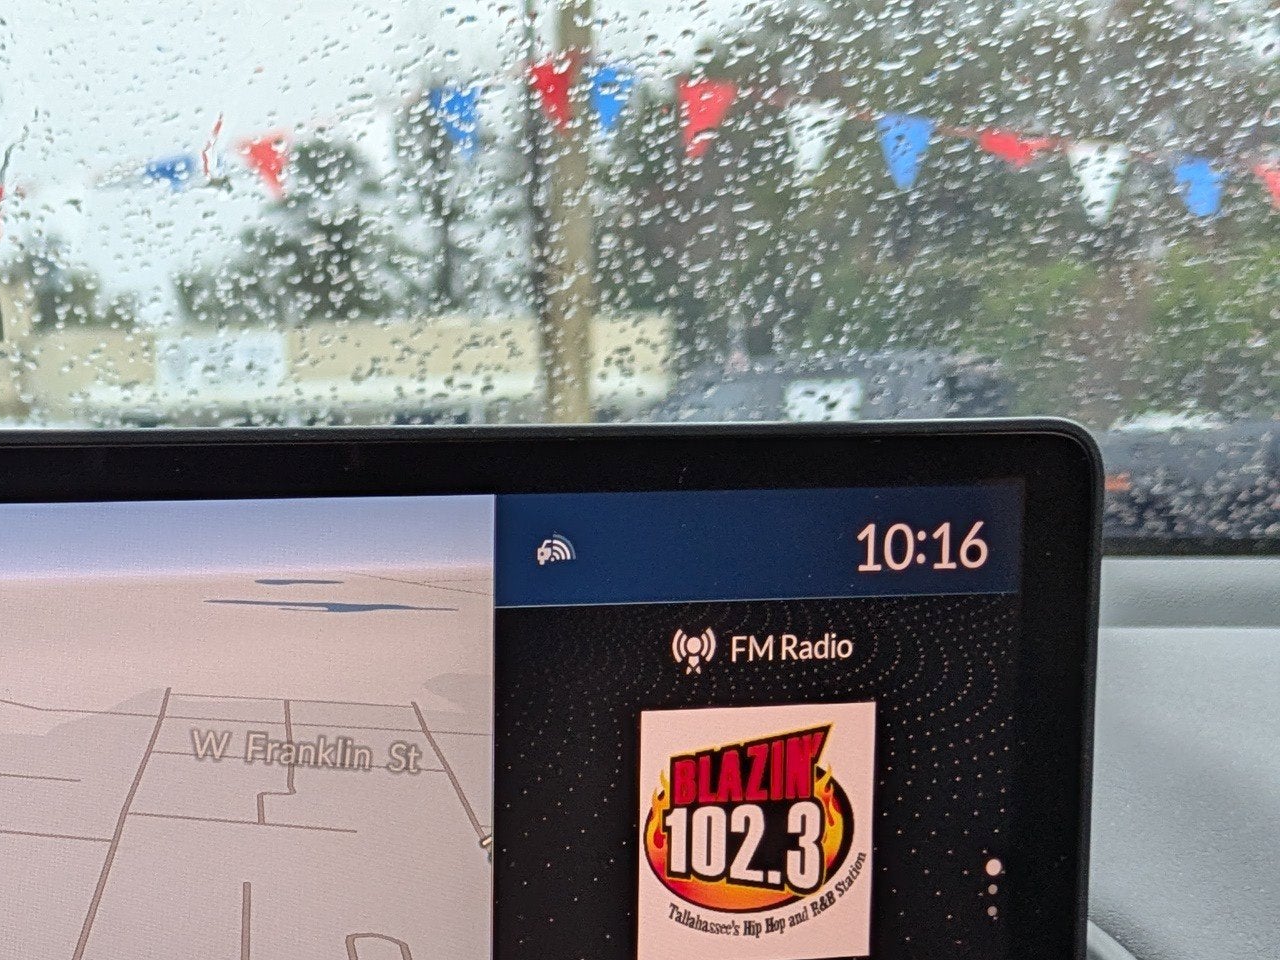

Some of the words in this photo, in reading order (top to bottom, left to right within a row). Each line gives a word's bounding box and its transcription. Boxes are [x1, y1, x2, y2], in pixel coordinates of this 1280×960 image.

[856, 521, 988, 572] 10:16
[731, 635, 774, 662] FM
[781, 633, 853, 661] Radio
[192, 730, 228, 759] W
[246, 733, 371, 769] Franklin
[389, 743, 421, 773] St
[665, 801, 821, 889] 102.3
[668, 903, 740, 936] Tallahassee's
[743, 920, 762, 938] Hip
[765, 916, 786, 934] Hop
[789, 908, 809, 926] and
[811, 892, 837, 918] R&B
[835, 851, 867, 898] Station
